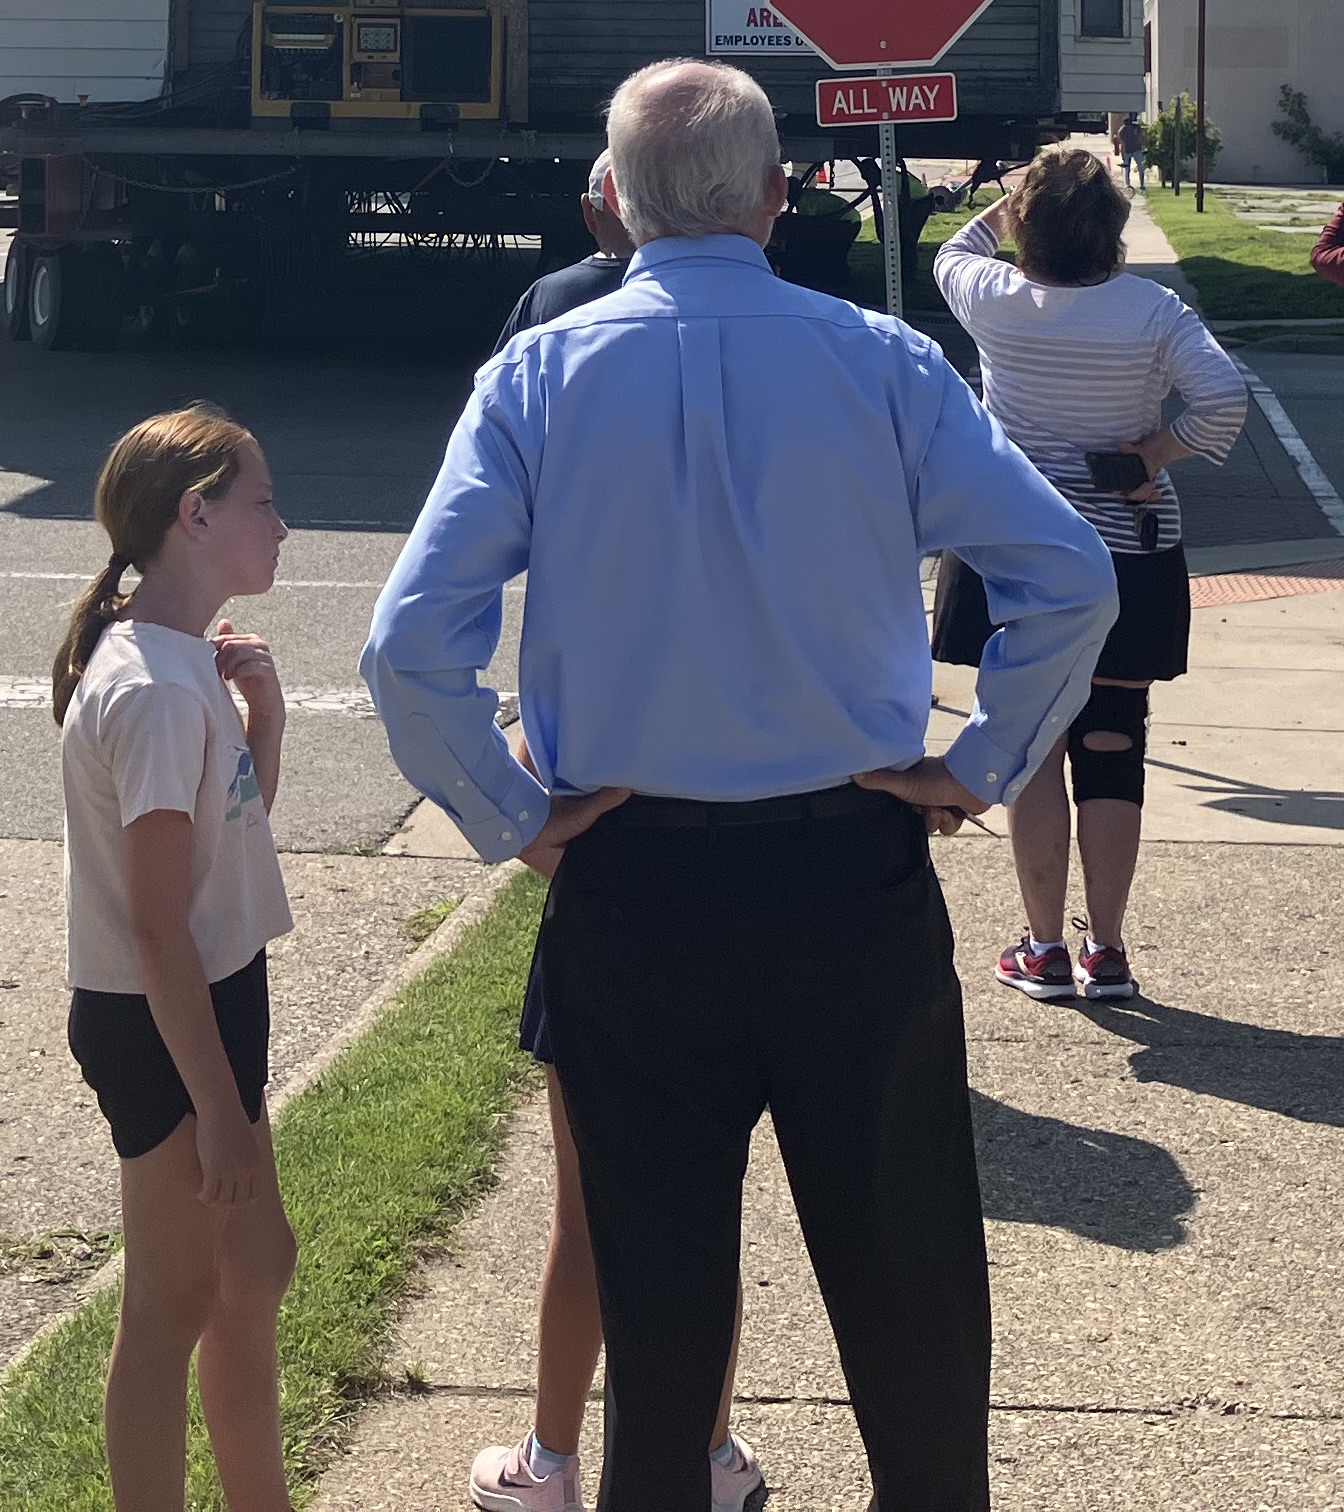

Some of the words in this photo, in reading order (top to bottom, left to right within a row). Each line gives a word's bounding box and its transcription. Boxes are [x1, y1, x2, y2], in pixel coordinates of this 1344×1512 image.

[746, 7, 789, 28] ARE
[715, 34, 792, 46] EMPLOYEES
[831, 88, 878, 116] ALL
[888, 84, 940, 112] WAY
